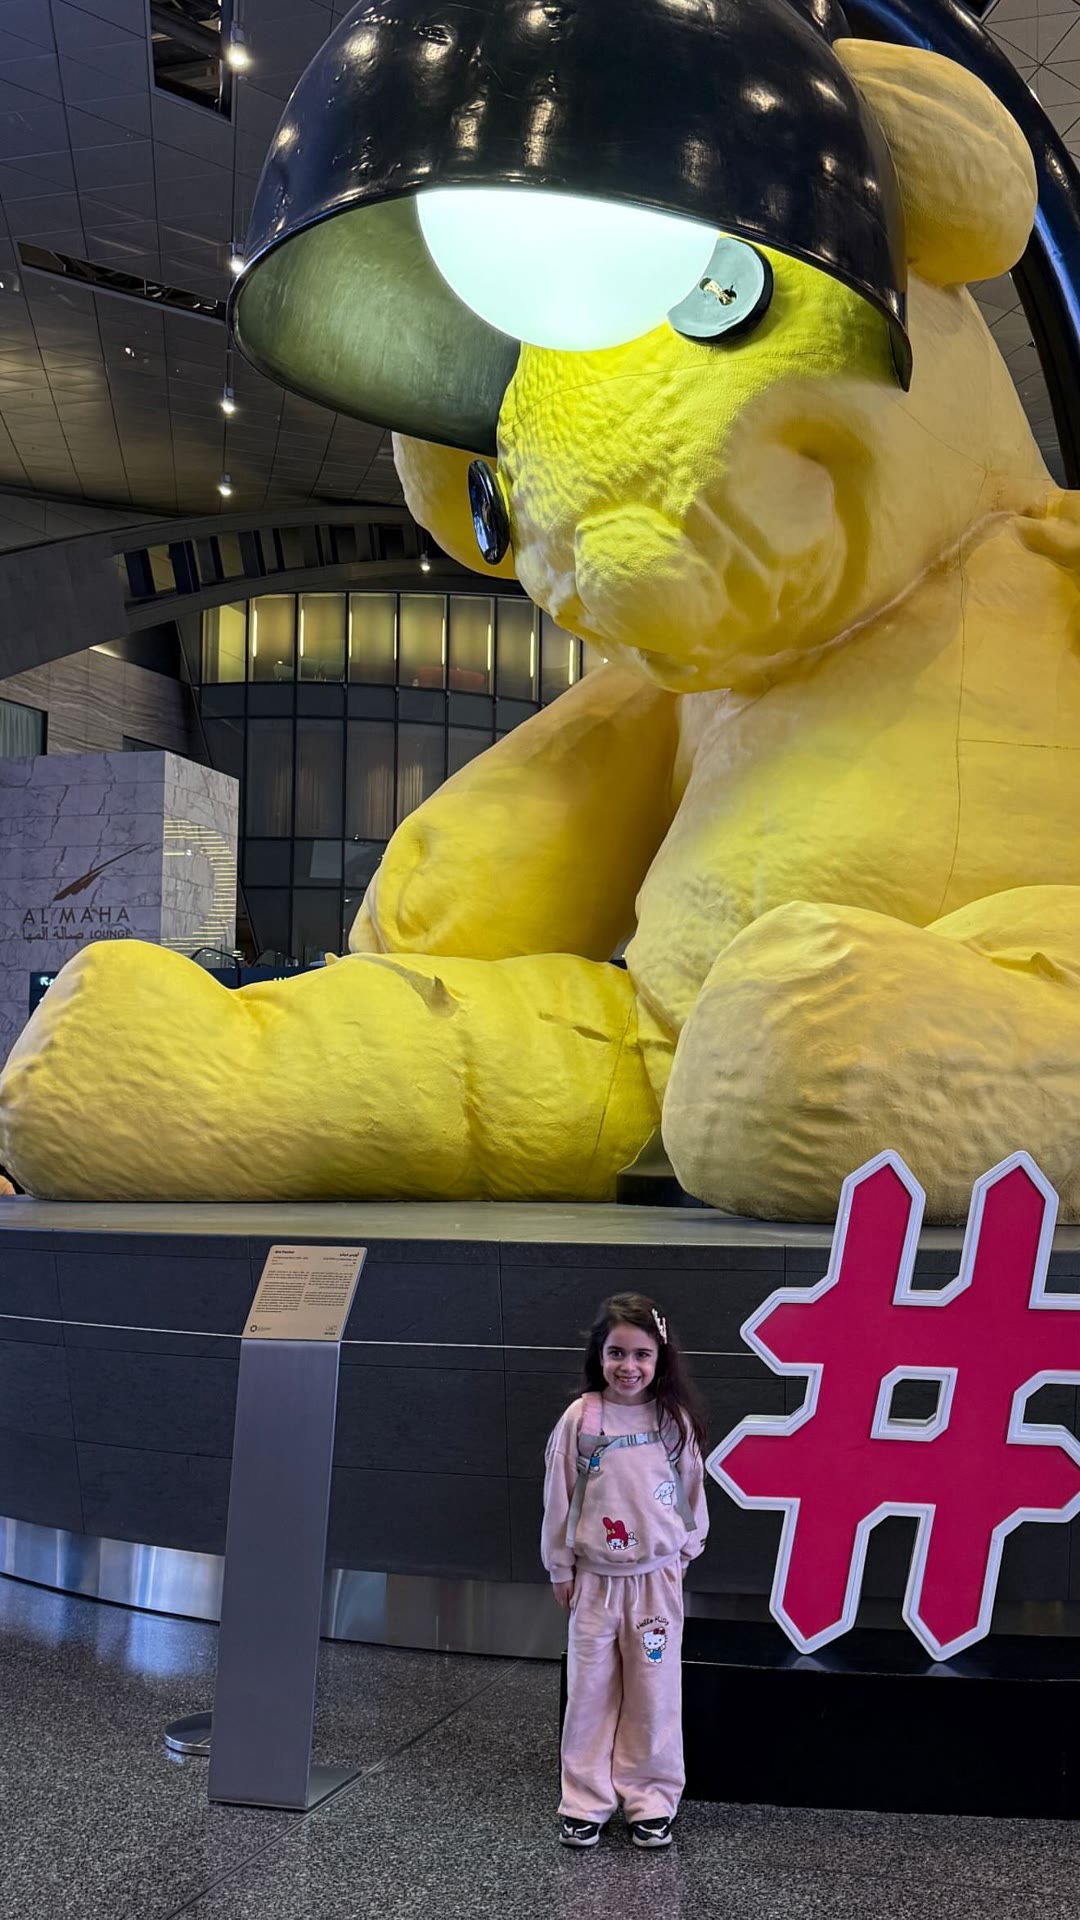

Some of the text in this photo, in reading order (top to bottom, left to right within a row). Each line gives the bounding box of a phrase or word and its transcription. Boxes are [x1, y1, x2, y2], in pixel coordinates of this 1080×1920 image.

[22, 906, 130, 924] AL MAHA
[53, 926, 84, 940] صالة
[90, 929, 132, 939] LOUNGE
[706, 1149, 1080, 1662] #
